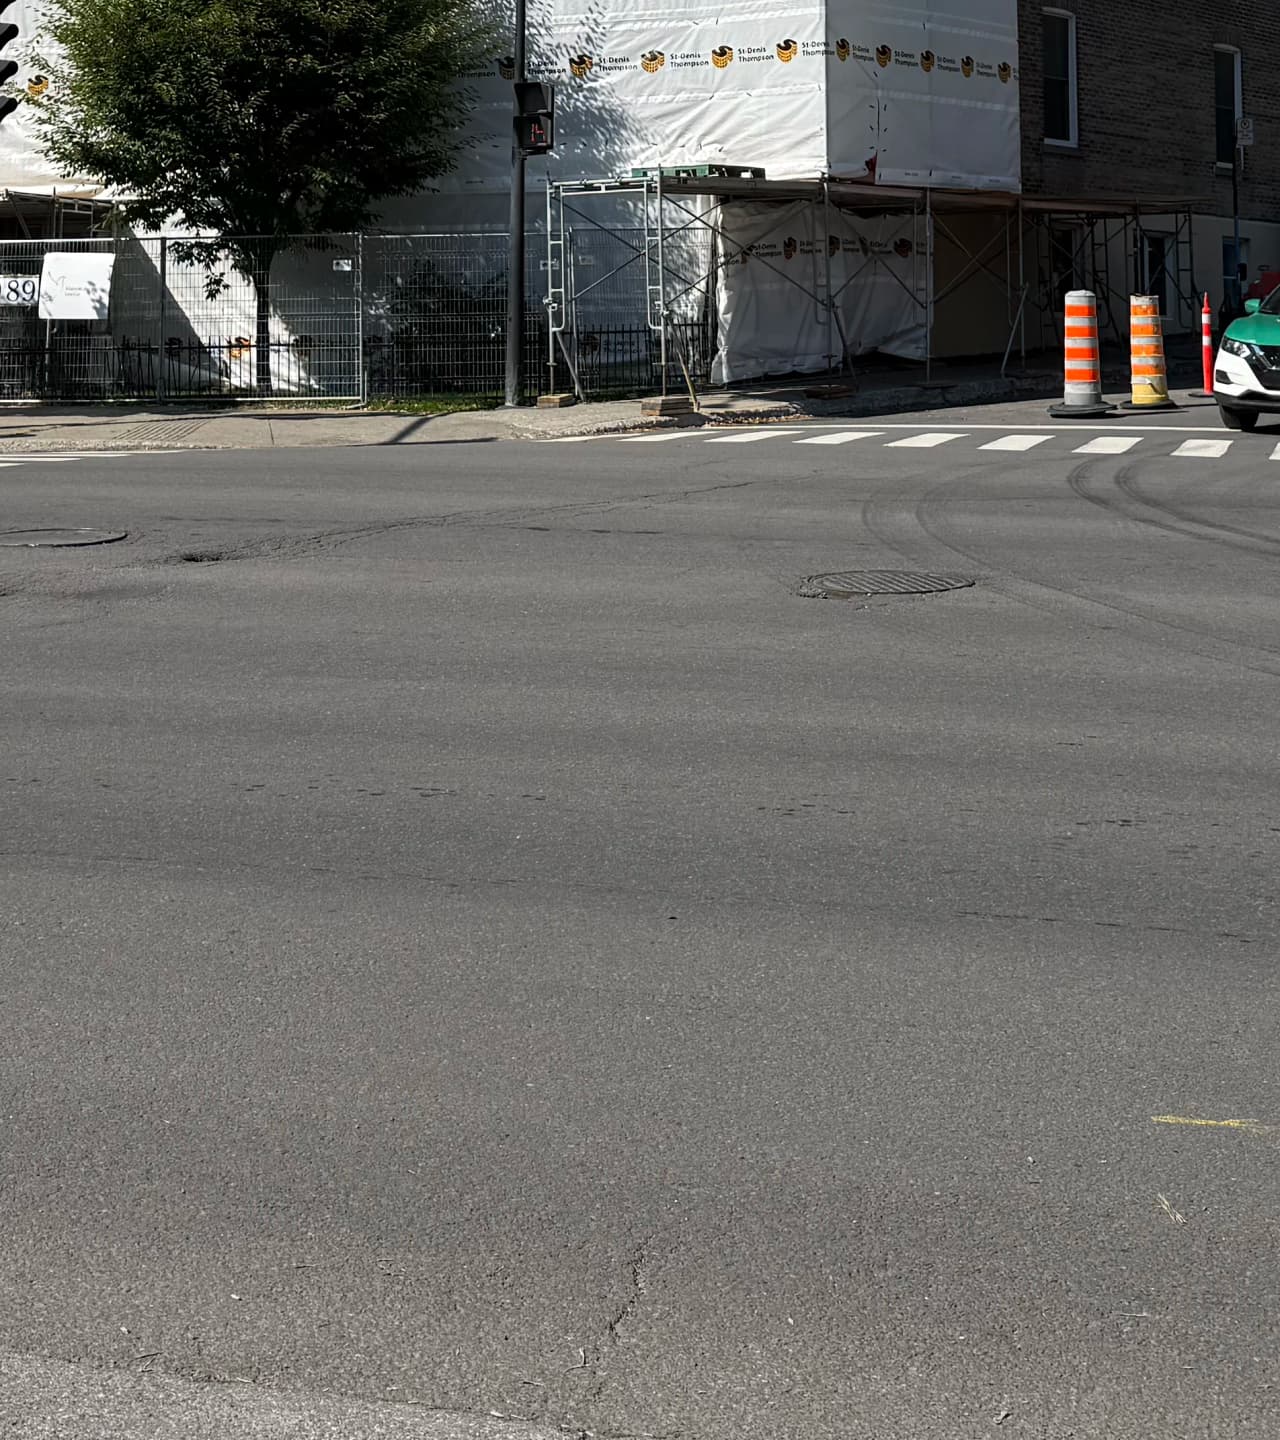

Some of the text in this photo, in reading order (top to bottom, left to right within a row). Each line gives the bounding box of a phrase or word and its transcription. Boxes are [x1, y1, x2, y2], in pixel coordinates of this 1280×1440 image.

[738, 47, 767, 55] St-Denis
[598, 56, 630, 64] St-Denis
[670, 52, 701, 61] St-Denis
[738, 54, 774, 63] Thompson
[598, 64, 638, 72] Thompson
[670, 60, 709, 68] Thompson
